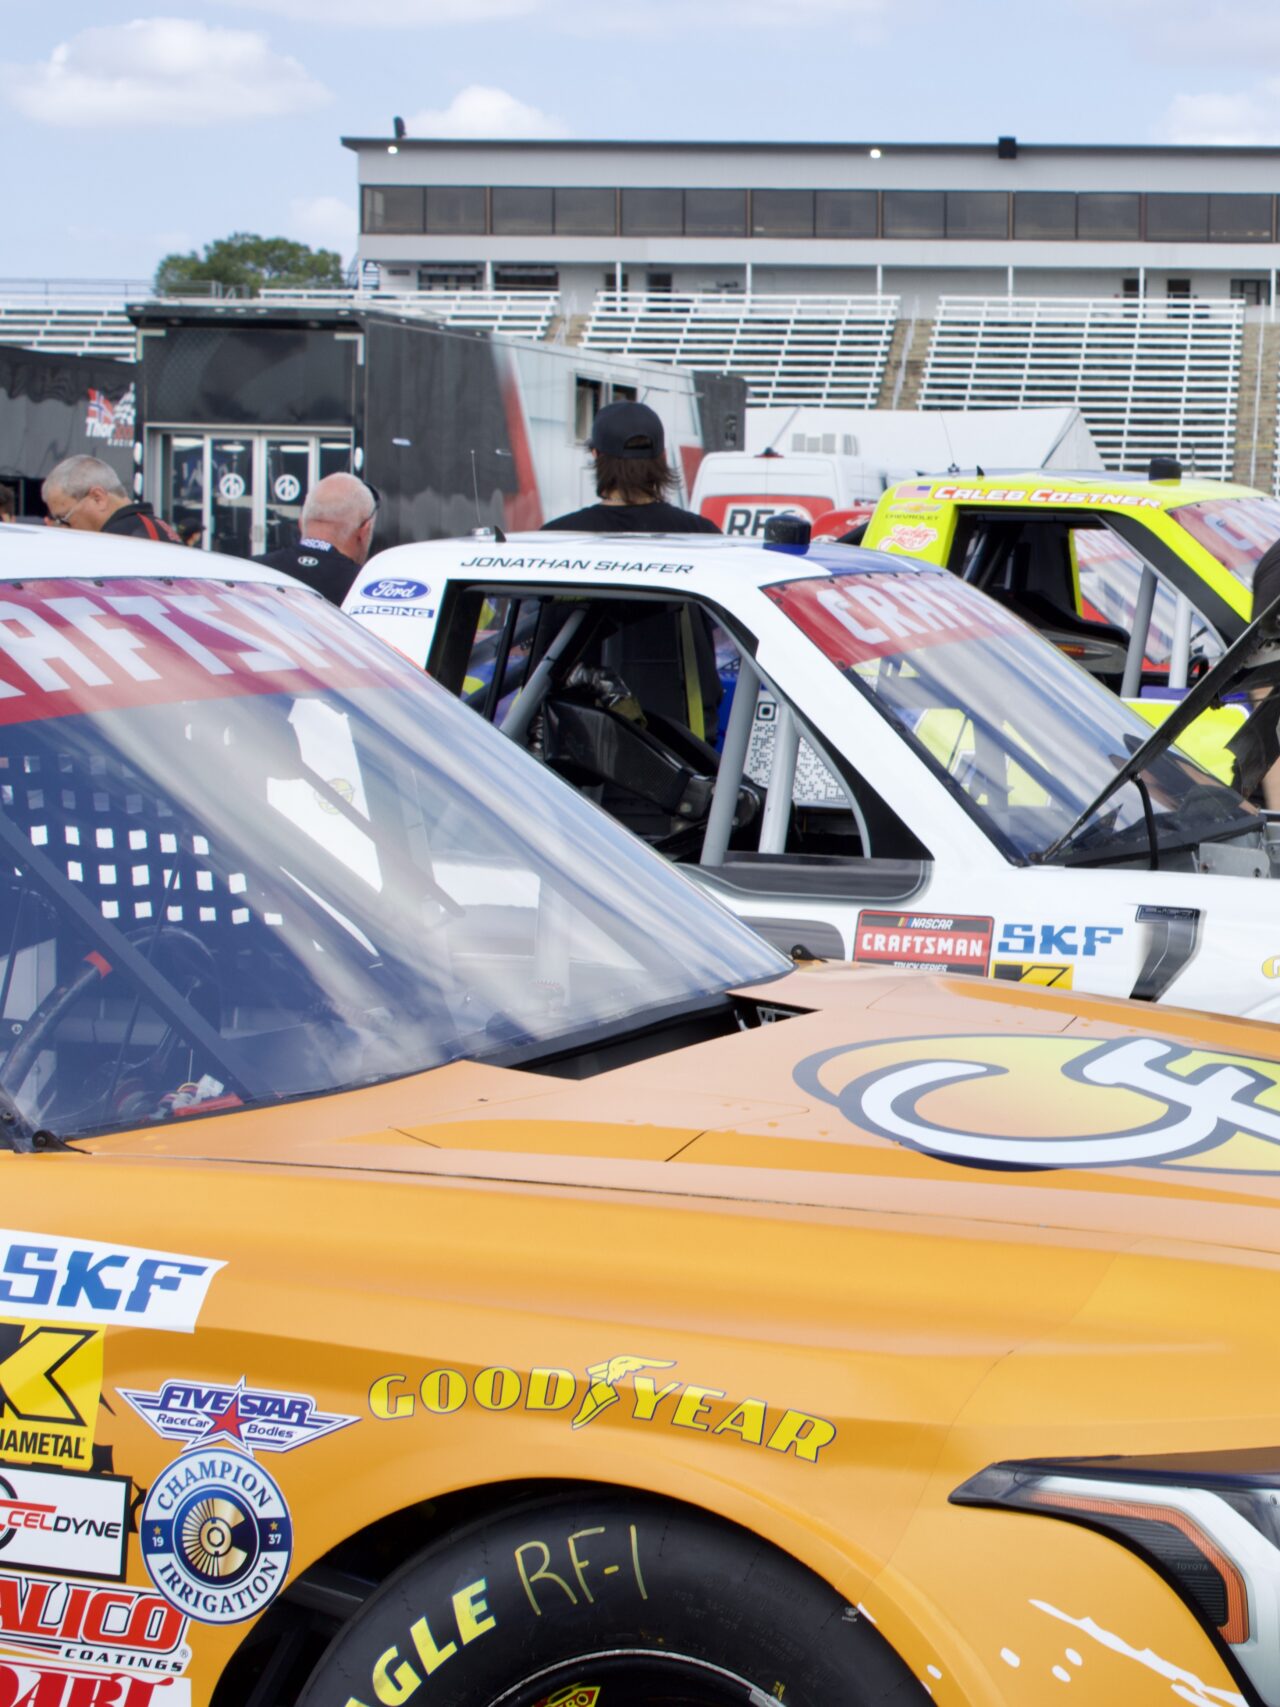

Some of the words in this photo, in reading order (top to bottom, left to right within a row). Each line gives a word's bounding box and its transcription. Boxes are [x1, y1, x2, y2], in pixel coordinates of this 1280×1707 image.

[933, 485, 1028, 501] CALEB
[1029, 487, 1163, 509] COSTNER
[727, 509, 797, 536] RF
[460, 556, 590, 570] JONATHAN
[594, 559, 695, 574] SHAFER
[370, 579, 417, 599] Ford
[350, 606, 430, 618] RACING
[910, 917, 953, 930] NASCAR
[861, 932, 983, 957] CRAFTSMAN
[997, 923, 1124, 956] SKF
[0, 1244, 209, 1314] SKF
[159, 1386, 236, 1411] FIVE
[239, 1393, 311, 1425] STAR
[368, 1355, 836, 1464] GOODYEAR
[156, 1413, 210, 1429] RaceCar
[247, 1424, 294, 1439] Bodies
[157, 1460, 273, 1511] CHAMPION
[0, 1505, 121, 1539] CELDYNE
[152, 1536, 165, 1548] 19
[268, 1533, 282, 1545] 37
[158, 1557, 279, 1614] IRRIGATION
[345, 1578, 497, 1707] GLE
[64, 1648, 184, 1673] COATINGS
